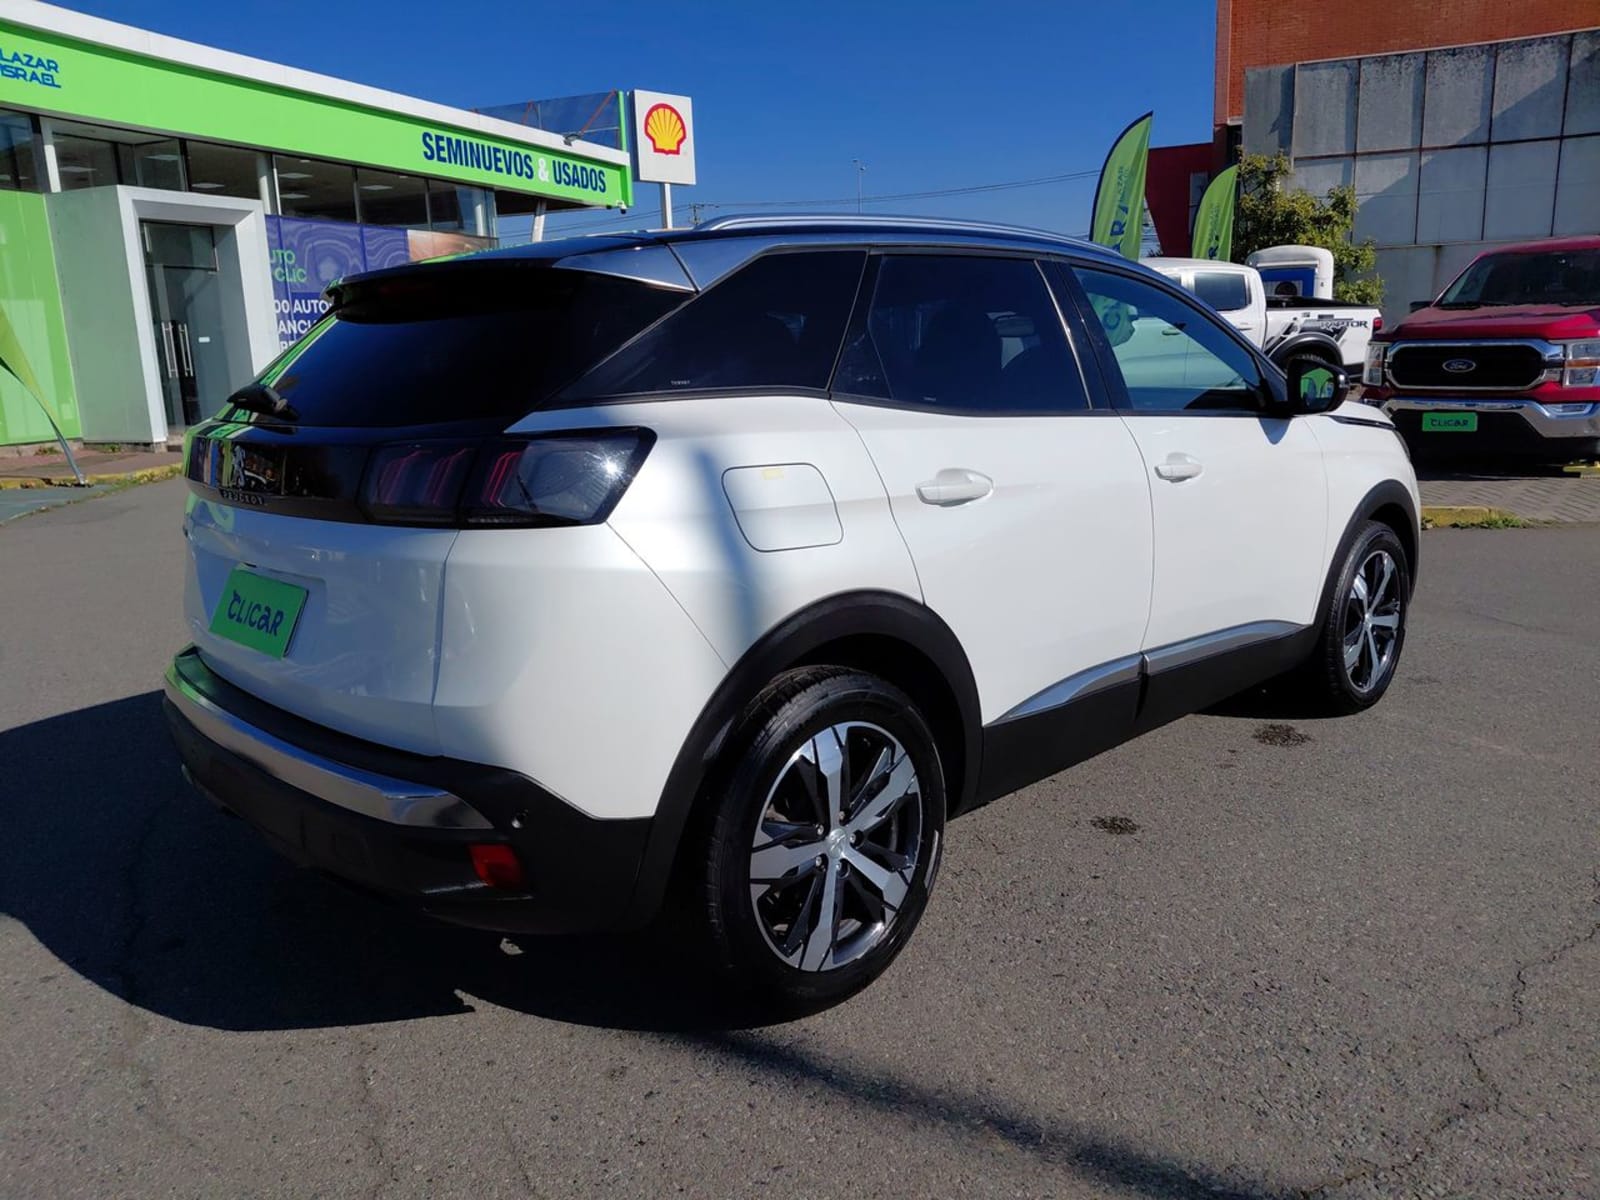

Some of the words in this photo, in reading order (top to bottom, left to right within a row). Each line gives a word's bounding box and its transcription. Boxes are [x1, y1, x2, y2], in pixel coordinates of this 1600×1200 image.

[422, 132, 534, 180] SEMINUEVOS
[537, 157, 549, 182] &
[552, 160, 606, 193] USADOS
[293, 299, 333, 314] AUTO
